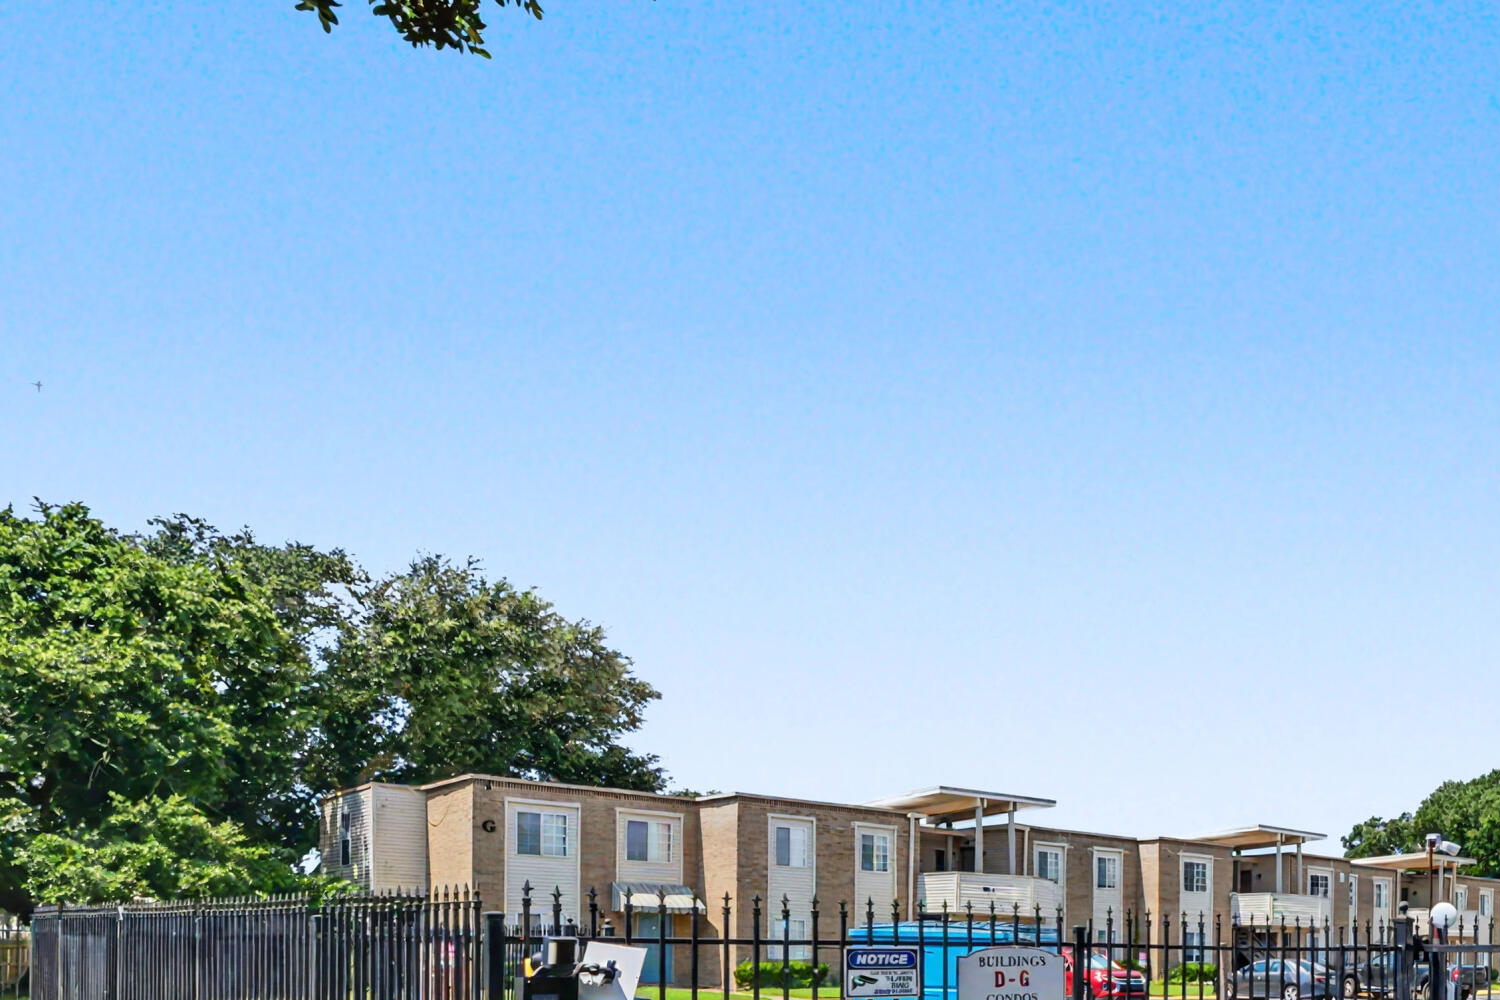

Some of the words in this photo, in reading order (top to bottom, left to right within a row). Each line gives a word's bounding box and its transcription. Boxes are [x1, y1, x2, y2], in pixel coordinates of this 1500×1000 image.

[482, 820, 497, 832] G
[856, 953, 908, 965] NOTICE
[978, 956, 1046, 967] BUILDINGS
